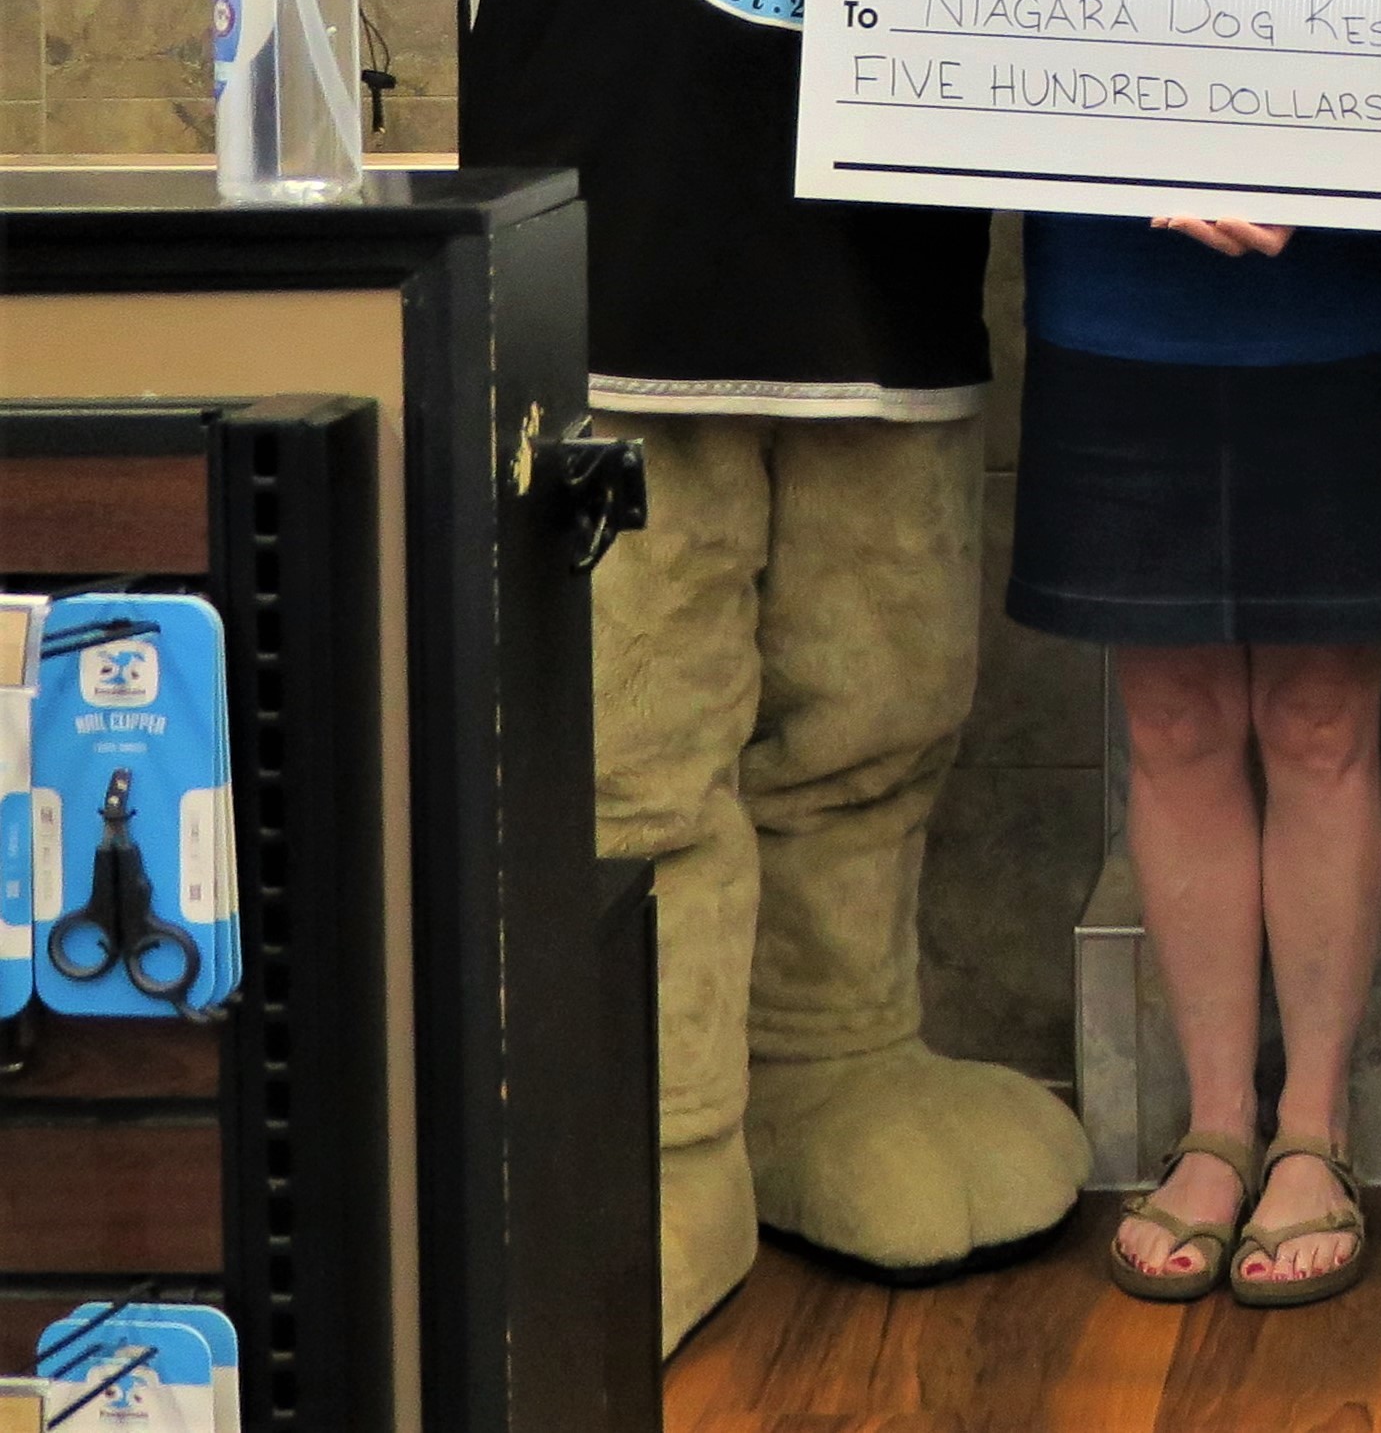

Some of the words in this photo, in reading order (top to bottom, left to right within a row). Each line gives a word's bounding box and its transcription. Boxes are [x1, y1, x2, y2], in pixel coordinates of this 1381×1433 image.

[844, 1, 878, 29] To
[853, 55, 964, 102] FIVE
[990, 63, 1189, 111] HUNDRED
